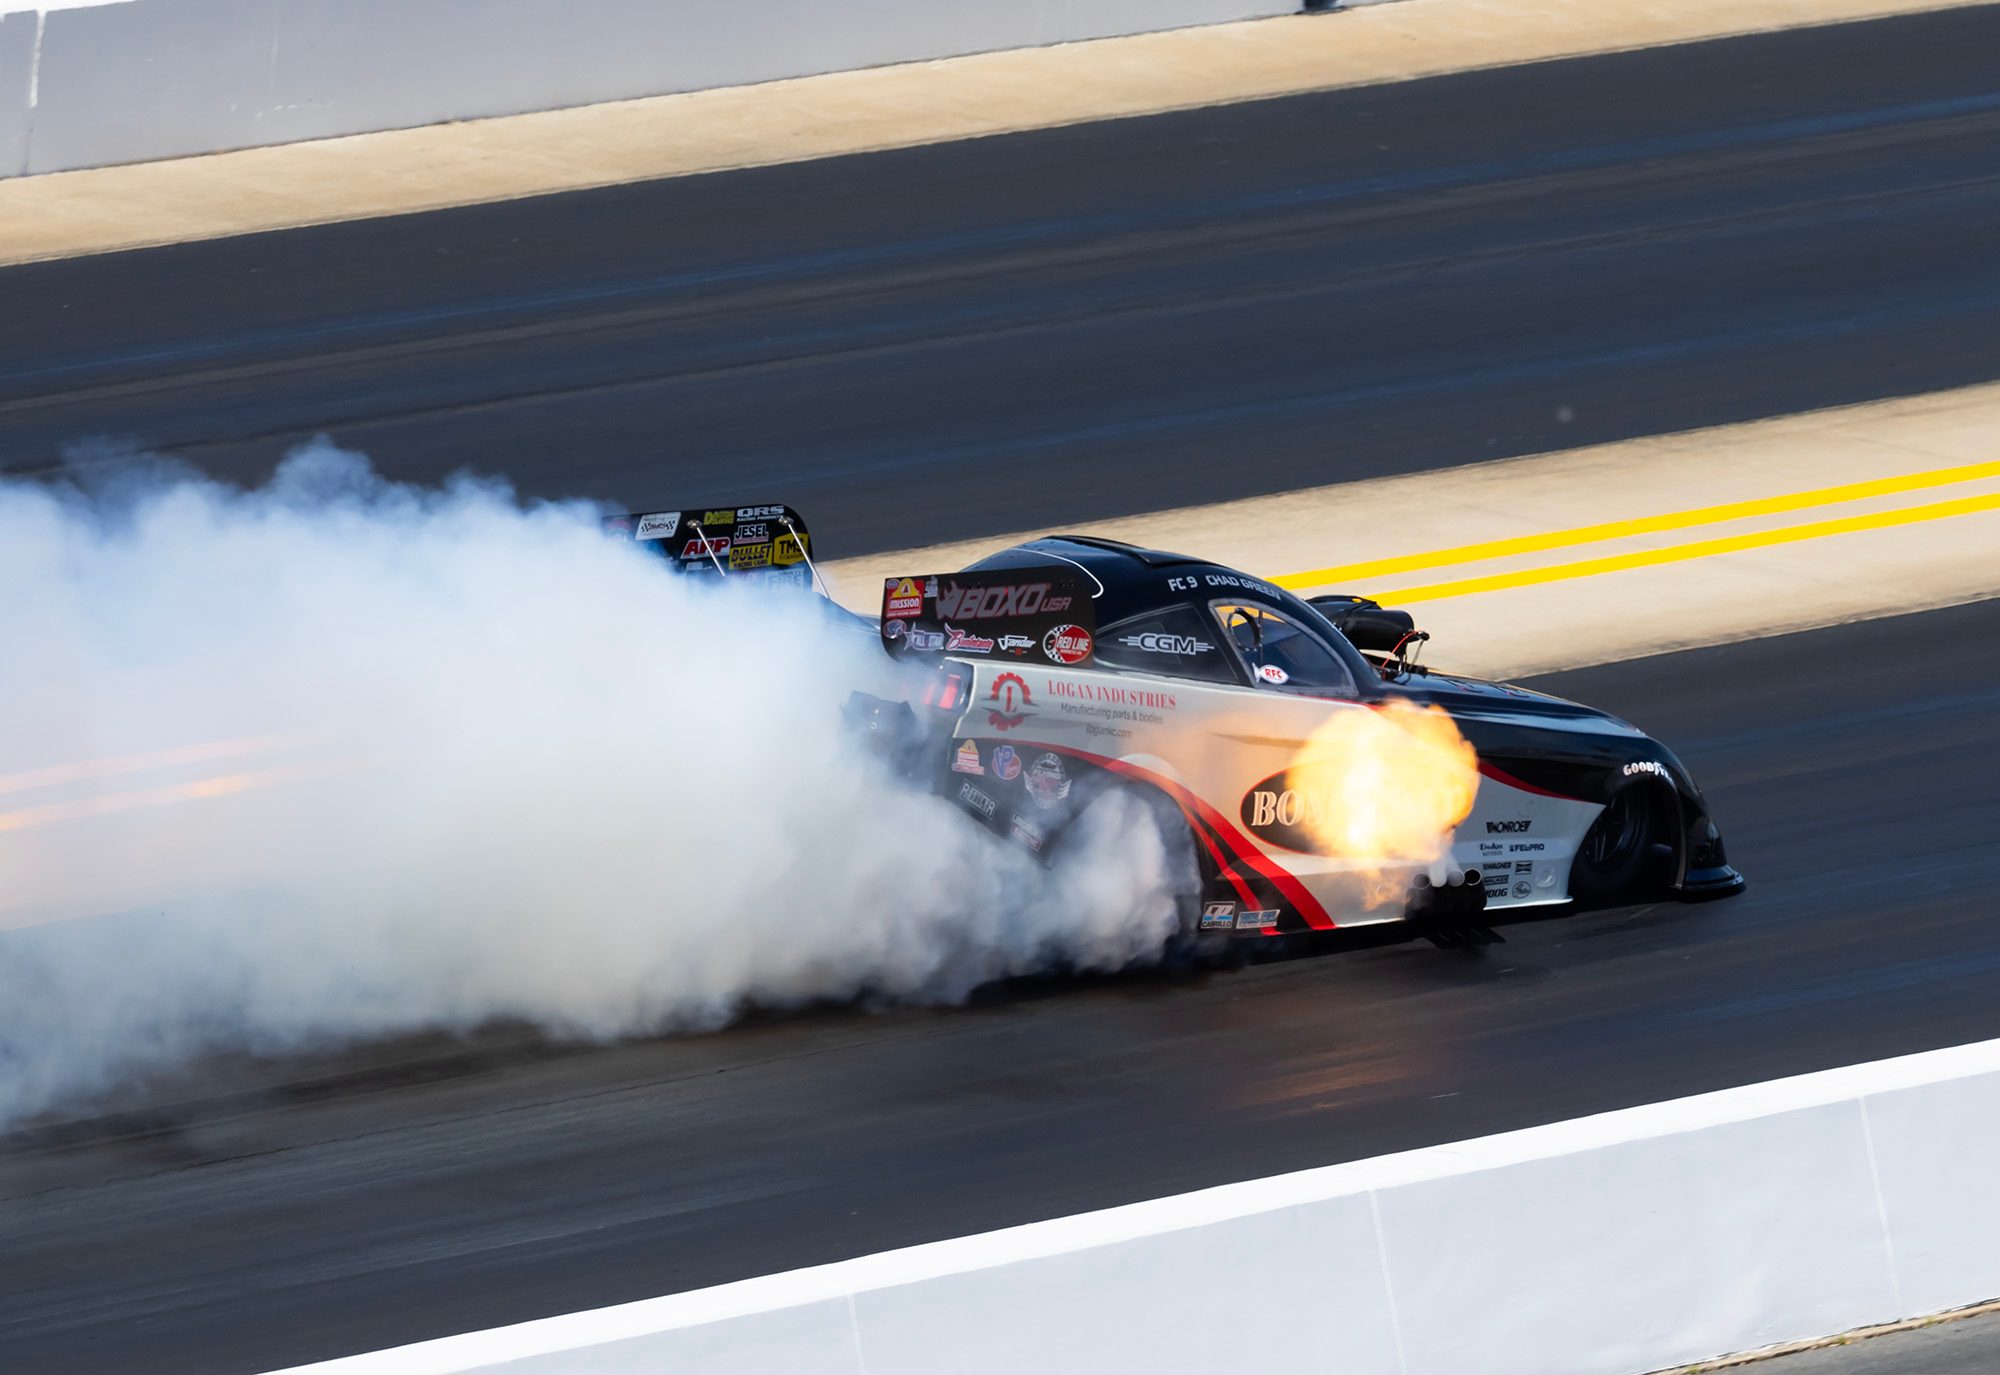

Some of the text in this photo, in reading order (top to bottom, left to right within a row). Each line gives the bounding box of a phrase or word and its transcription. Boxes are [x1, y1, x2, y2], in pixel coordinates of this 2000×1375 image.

[737, 506, 784, 517] QRS
[735, 524, 768, 538] JESEL
[683, 538, 730, 556] ARP
[731, 545, 771, 562] BULLET
[779, 539, 804, 554] TMS
[1168, 575, 1282, 600] FC 9 CHAD GREEN
[890, 598, 919, 608] MISSION
[954, 584, 1047, 619] BOXO
[1040, 597, 1072, 612] USA
[1057, 636, 1089, 651] RED LINE
[1140, 633, 1196, 655] CGM
[1265, 668, 1283, 679] RFC
[1048, 680, 1176, 709] LOGAN INDUSTRIES
[1061, 703, 1111, 720] Manufacturing
[1112, 709, 1131, 721] parts
[1139, 711, 1163, 724] bodies
[1623, 761, 1674, 786] GOODY
[1486, 820, 1532, 833] MONROE
